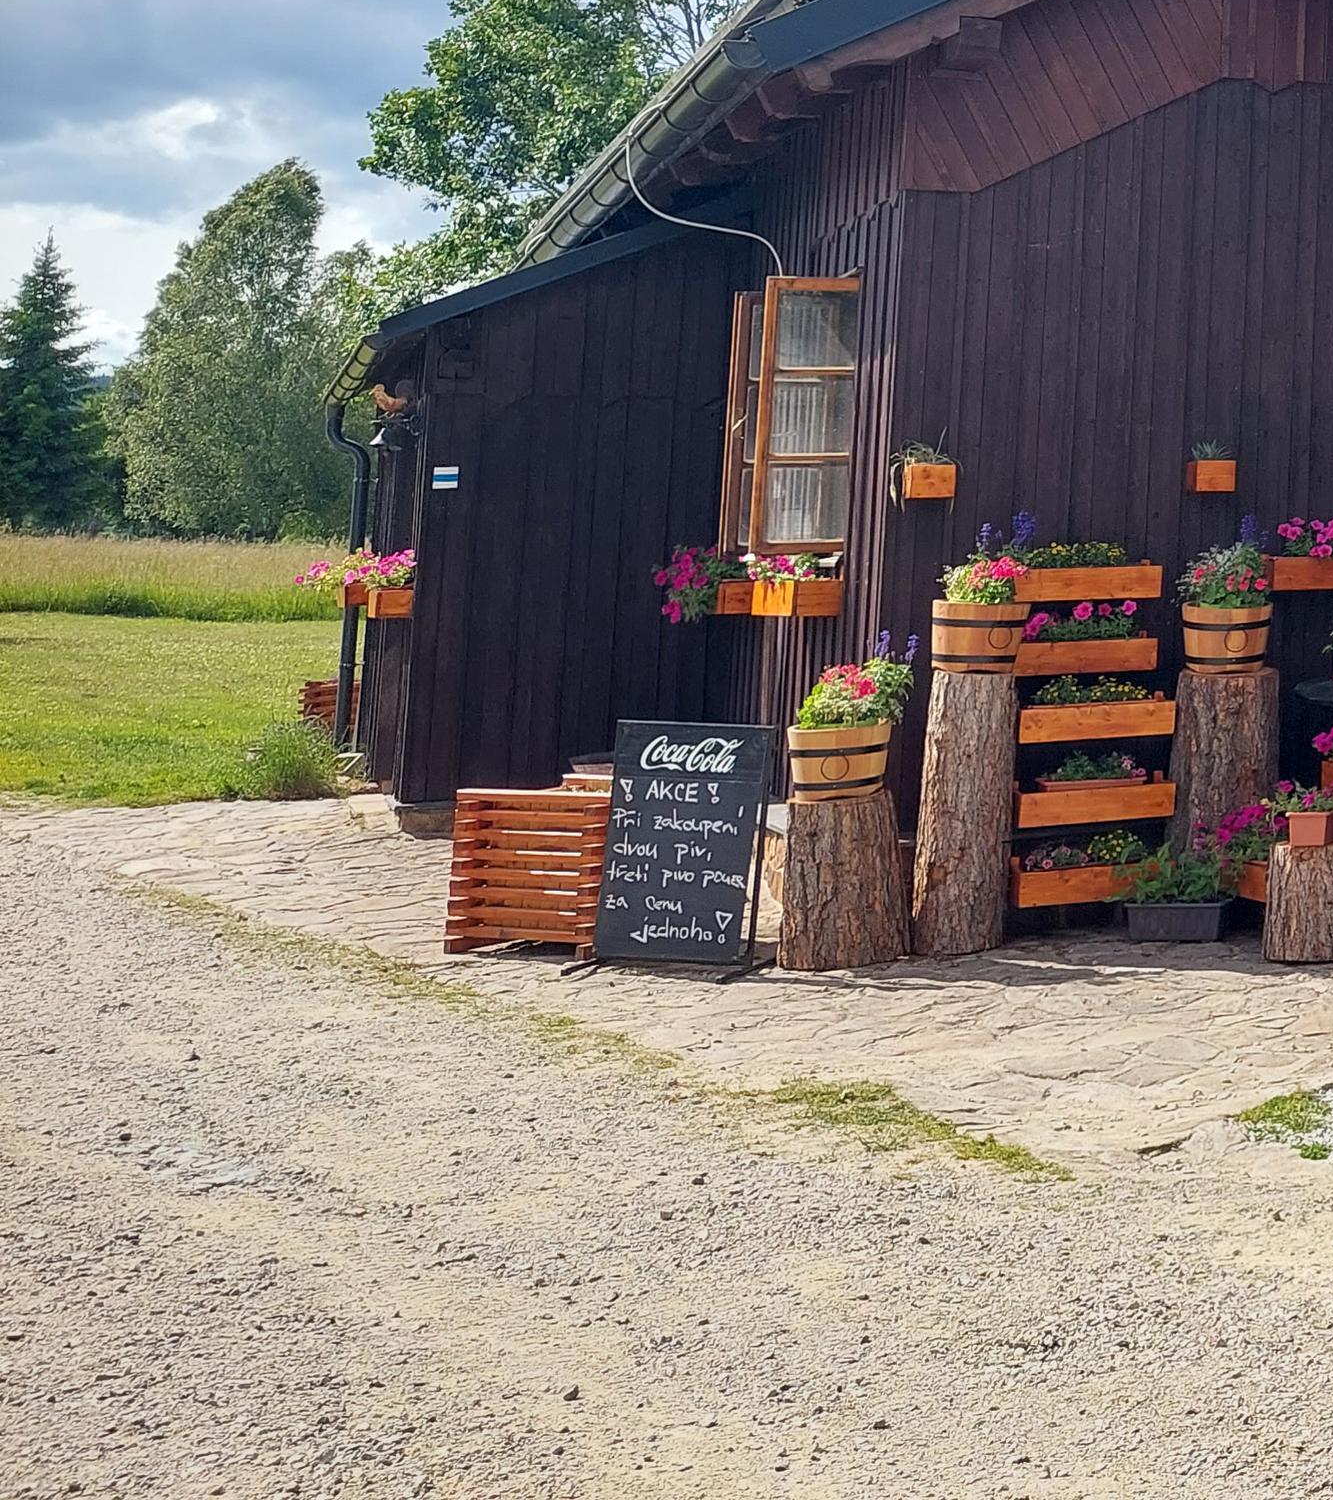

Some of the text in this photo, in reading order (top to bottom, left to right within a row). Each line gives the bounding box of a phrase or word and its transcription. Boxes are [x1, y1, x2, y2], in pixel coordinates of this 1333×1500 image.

[639, 734, 745, 775] Coca-Cola
[644, 778, 699, 804] AKCE
[611, 804, 745, 841] Při zakoupení
[612, 831, 658, 860] dvou
[605, 859, 746, 890] třetí pivo pouze
[604, 893, 629, 910] za
